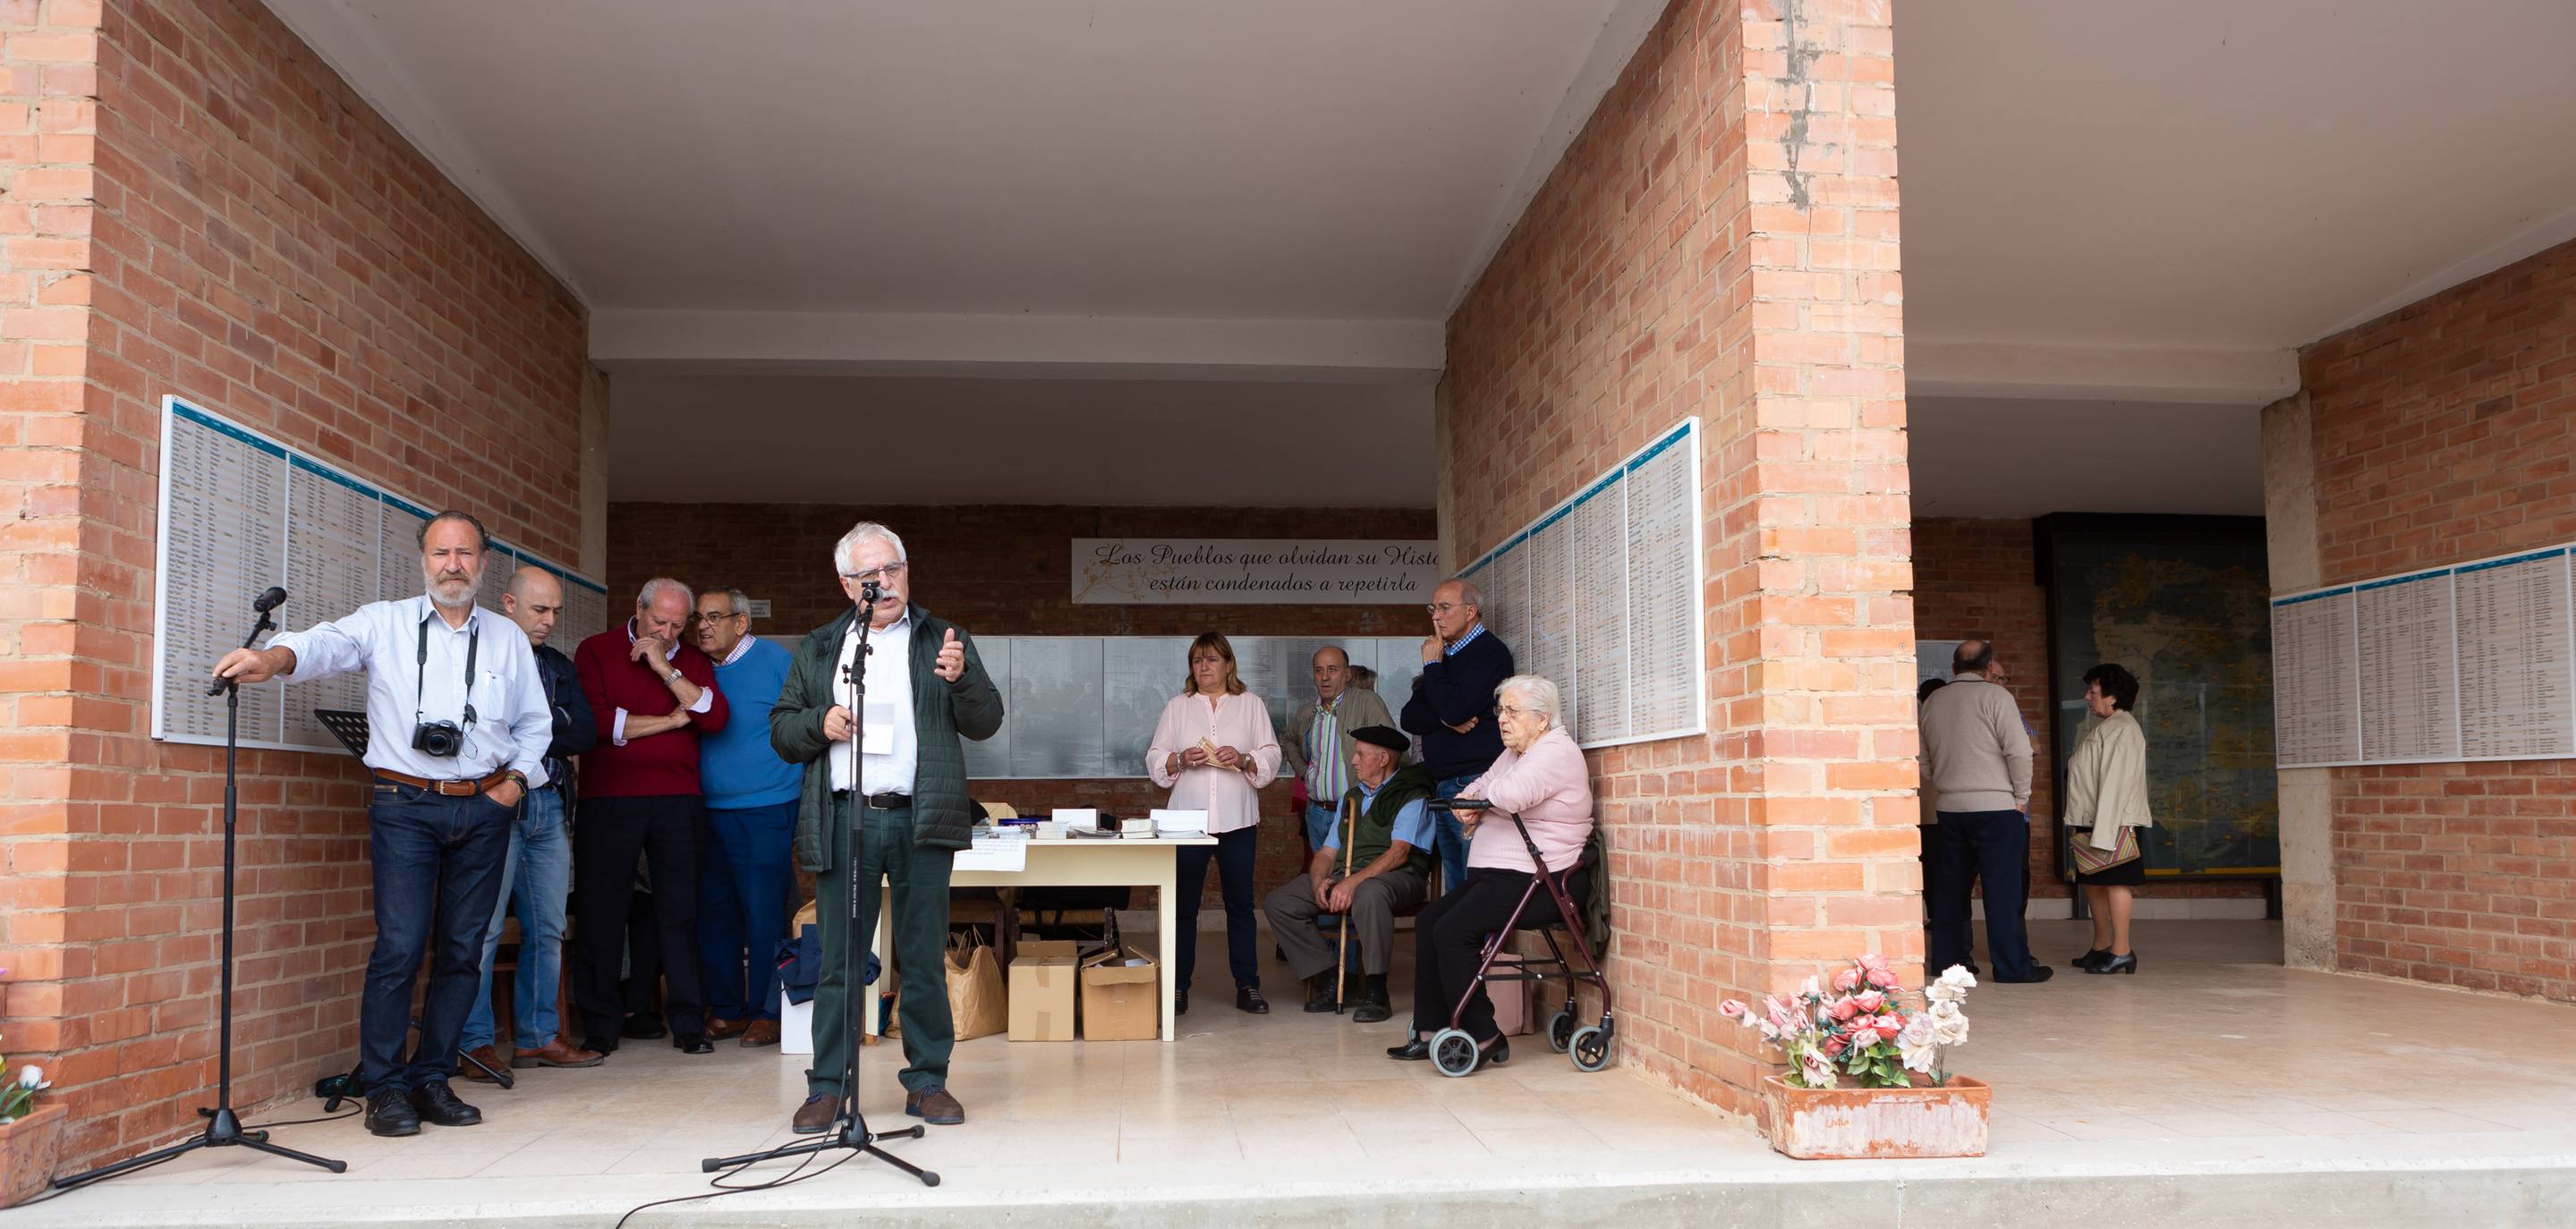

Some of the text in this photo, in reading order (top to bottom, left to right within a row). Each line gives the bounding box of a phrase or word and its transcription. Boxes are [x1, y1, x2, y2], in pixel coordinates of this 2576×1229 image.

[1095, 544, 1145, 565] Los
[1151, 544, 1236, 565] Pueblos
[1239, 552, 1274, 571] que
[1279, 545, 1352, 565] olvidan
[1356, 553, 1381, 565] su
[1150, 572, 1420, 598] están condenados a repetirla
